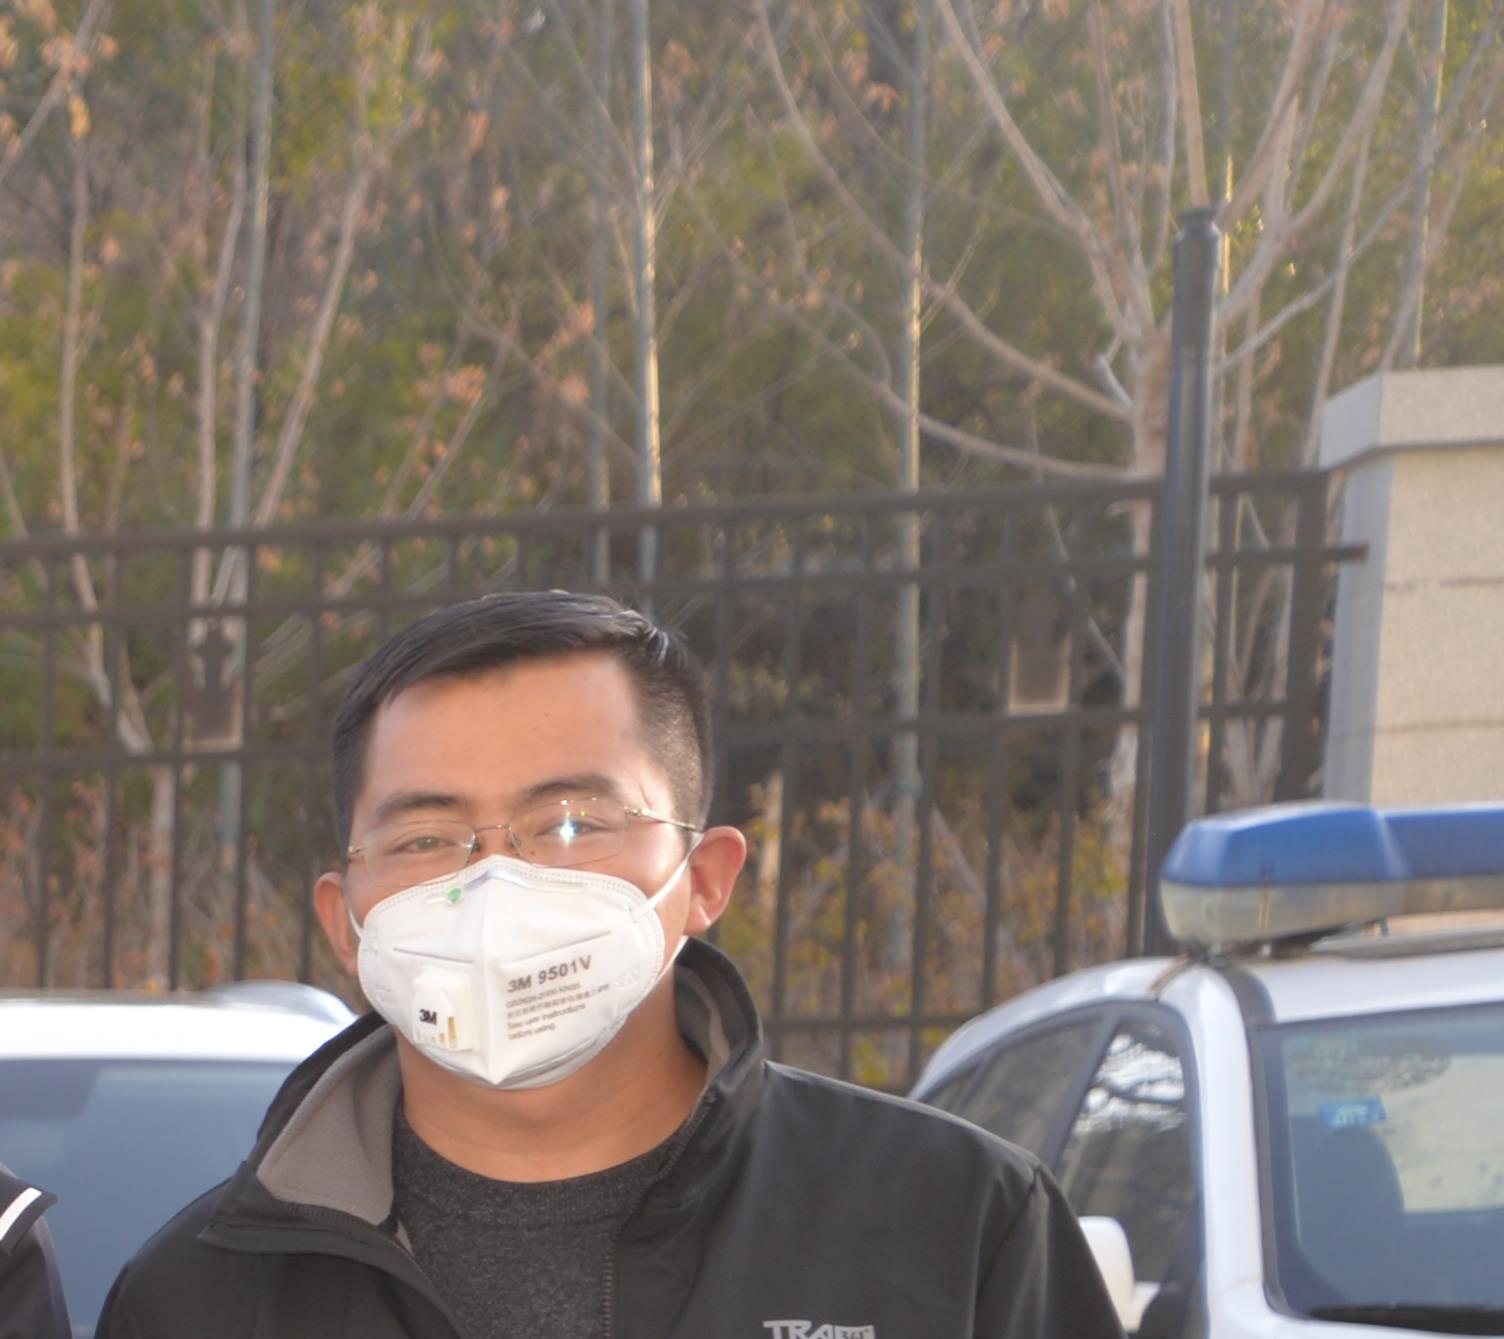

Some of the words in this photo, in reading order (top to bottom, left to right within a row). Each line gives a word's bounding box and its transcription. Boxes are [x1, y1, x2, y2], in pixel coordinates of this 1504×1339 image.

[507, 974, 532, 993] 3M
[538, 954, 592, 985] 9501V
[419, 1008, 437, 1026] 3M
